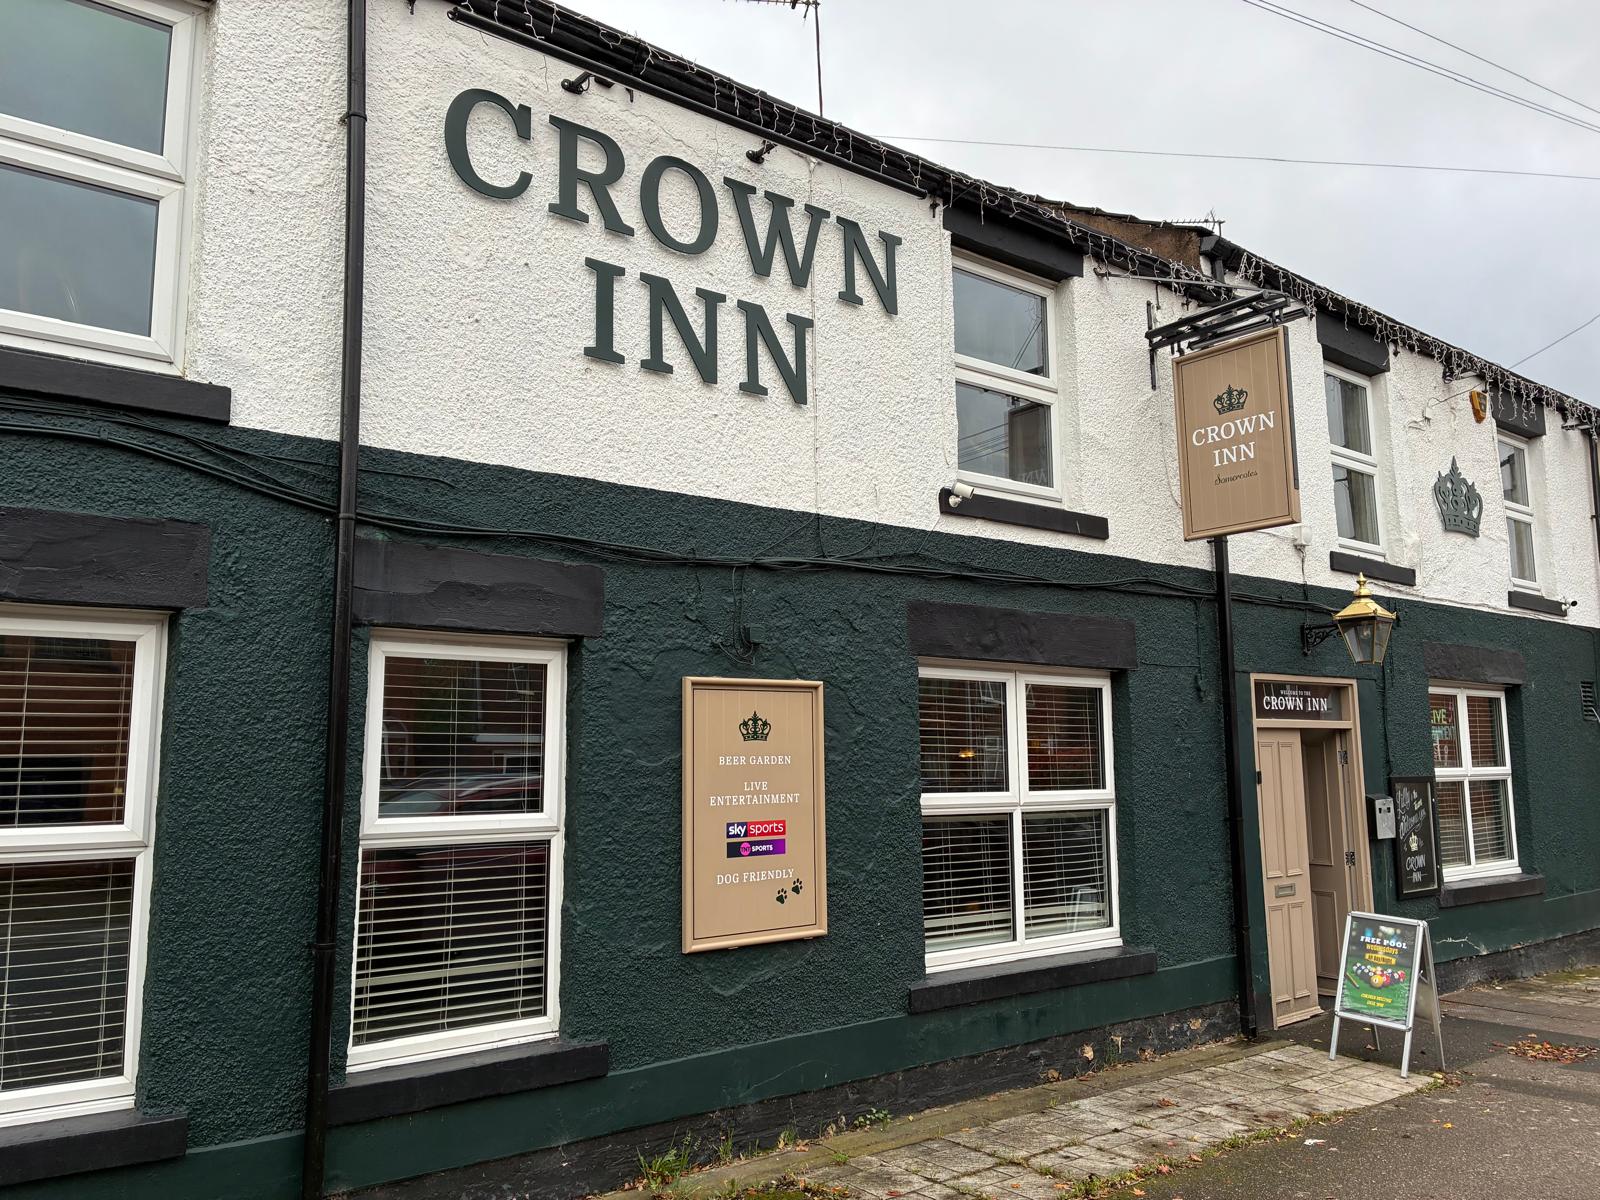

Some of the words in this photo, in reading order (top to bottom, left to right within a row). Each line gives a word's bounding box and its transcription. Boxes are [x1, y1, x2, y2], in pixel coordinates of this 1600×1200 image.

[444, 88, 902, 316] CROWN
[583, 256, 814, 405] INN
[1192, 411, 1275, 446] CROWN
[1213, 441, 1256, 467] INN
[1263, 695, 1304, 711] CROWN
[1307, 697, 1328, 711] INN
[1431, 708, 1447, 724] IVE
[719, 755, 746, 766] BEER
[749, 755, 792, 765] GARDEN
[744, 781, 768, 791] LIVE
[710, 793, 800, 806] ENTERTAINMENT
[728, 823, 746, 837] sky
[749, 822, 784, 835] sports
[752, 844, 774, 852] SPORTS
[1406, 855, 1425, 871] CROWN
[716, 872, 739, 884] DOG
[743, 869, 794, 883] FRIENDLY
[1412, 871, 1422, 883] INN
[1360, 936, 1381, 944] FREE
[1383, 940, 1407, 949] POOL
